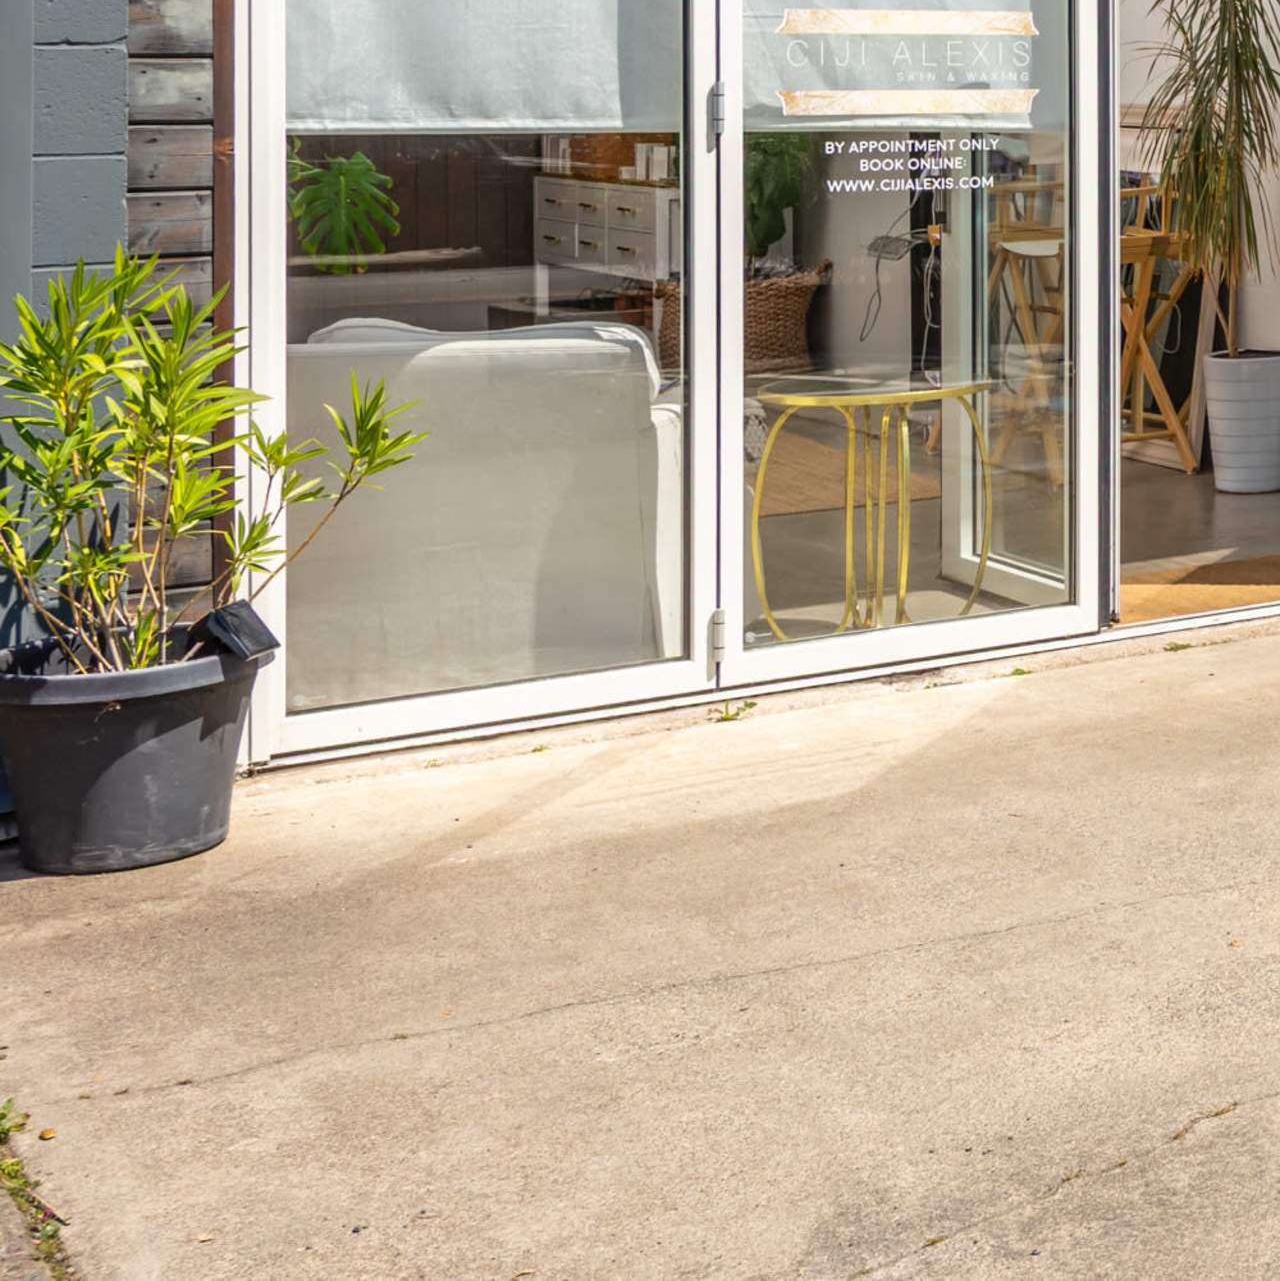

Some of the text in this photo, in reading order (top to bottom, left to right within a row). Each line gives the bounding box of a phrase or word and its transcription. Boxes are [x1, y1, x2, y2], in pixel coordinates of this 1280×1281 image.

[786, 39, 1031, 68] CIJI ALEXIS
[896, 71, 937, 83] SKIN
[966, 71, 1031, 83] WAXING
[824, 138, 1000, 155] BY APPOINTMENT ONLY
[859, 157, 968, 172] BOOK ONLINE:
[826, 176, 995, 193] WWW.CIJIALEXIS.COM
